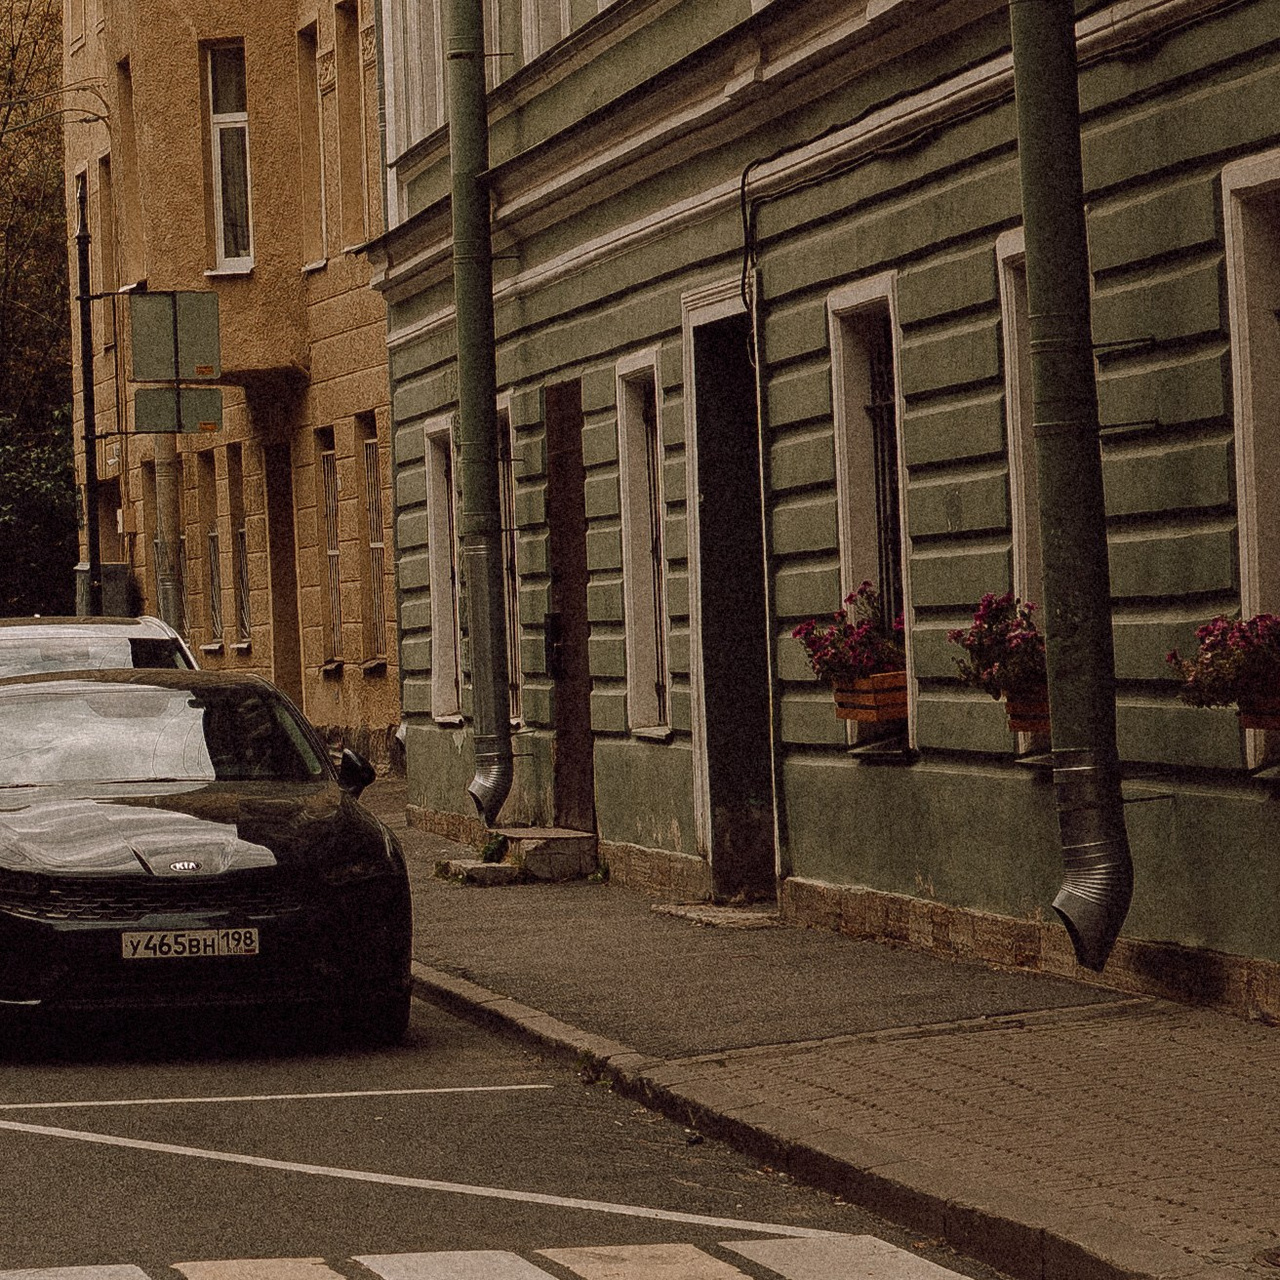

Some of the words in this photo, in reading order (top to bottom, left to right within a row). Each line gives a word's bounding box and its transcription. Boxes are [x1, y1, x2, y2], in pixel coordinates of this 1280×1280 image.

[174, 861, 198, 870] KIA
[129, 933, 216, 957] У465ВН
[221, 930, 253, 948] 198
